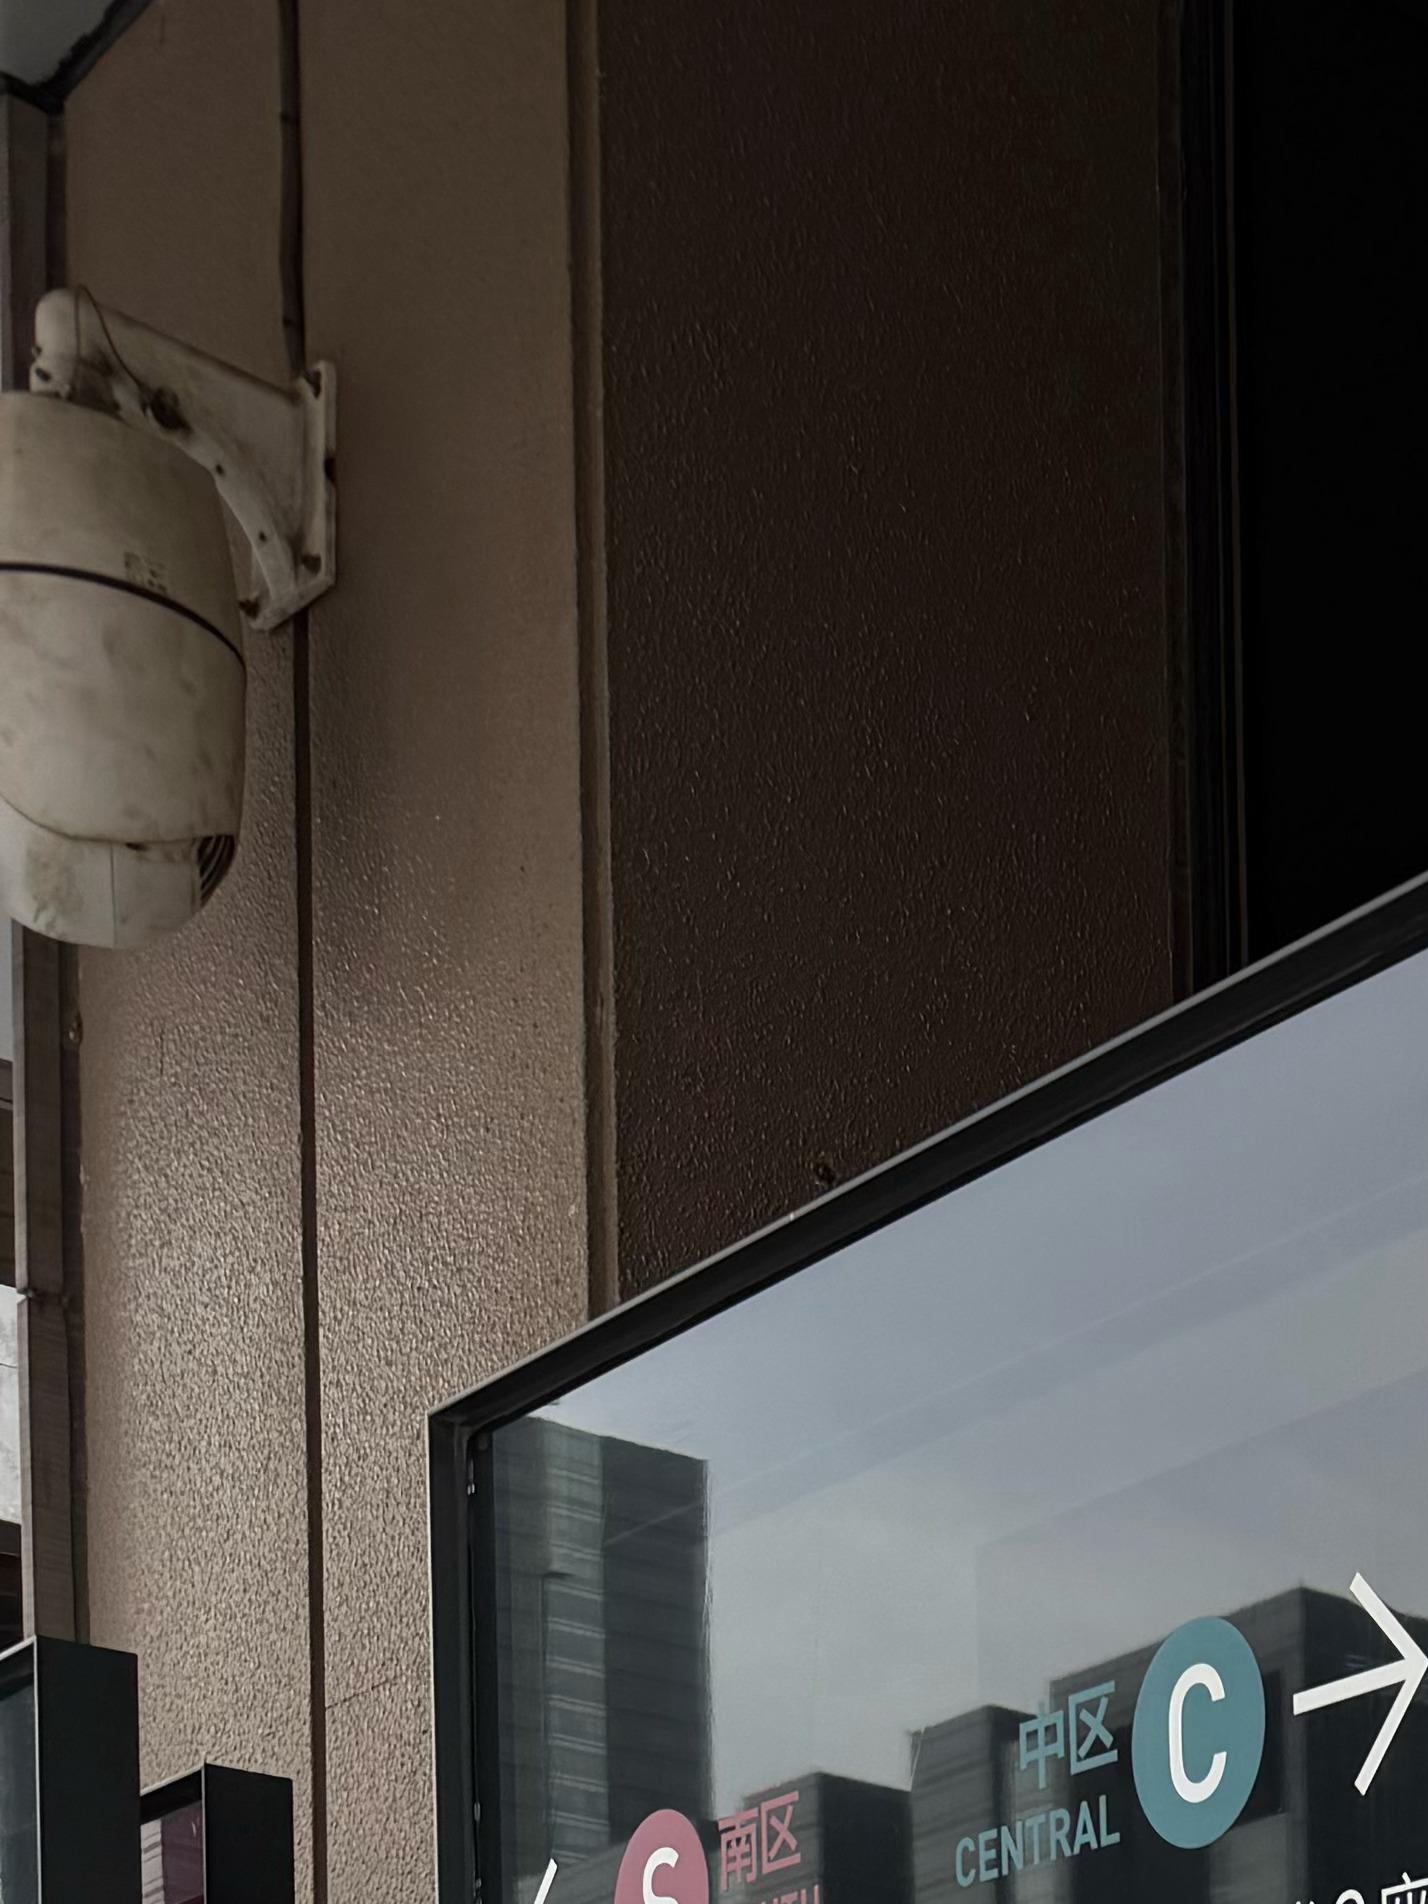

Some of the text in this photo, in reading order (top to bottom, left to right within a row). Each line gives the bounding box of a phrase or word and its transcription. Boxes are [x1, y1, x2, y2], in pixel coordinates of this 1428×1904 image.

[1018, 1680, 1118, 1789] 中区
[1168, 1662, 1228, 1804] C
[718, 1790, 801, 1891] 南区
[955, 1795, 1121, 1887] CENTRAL
